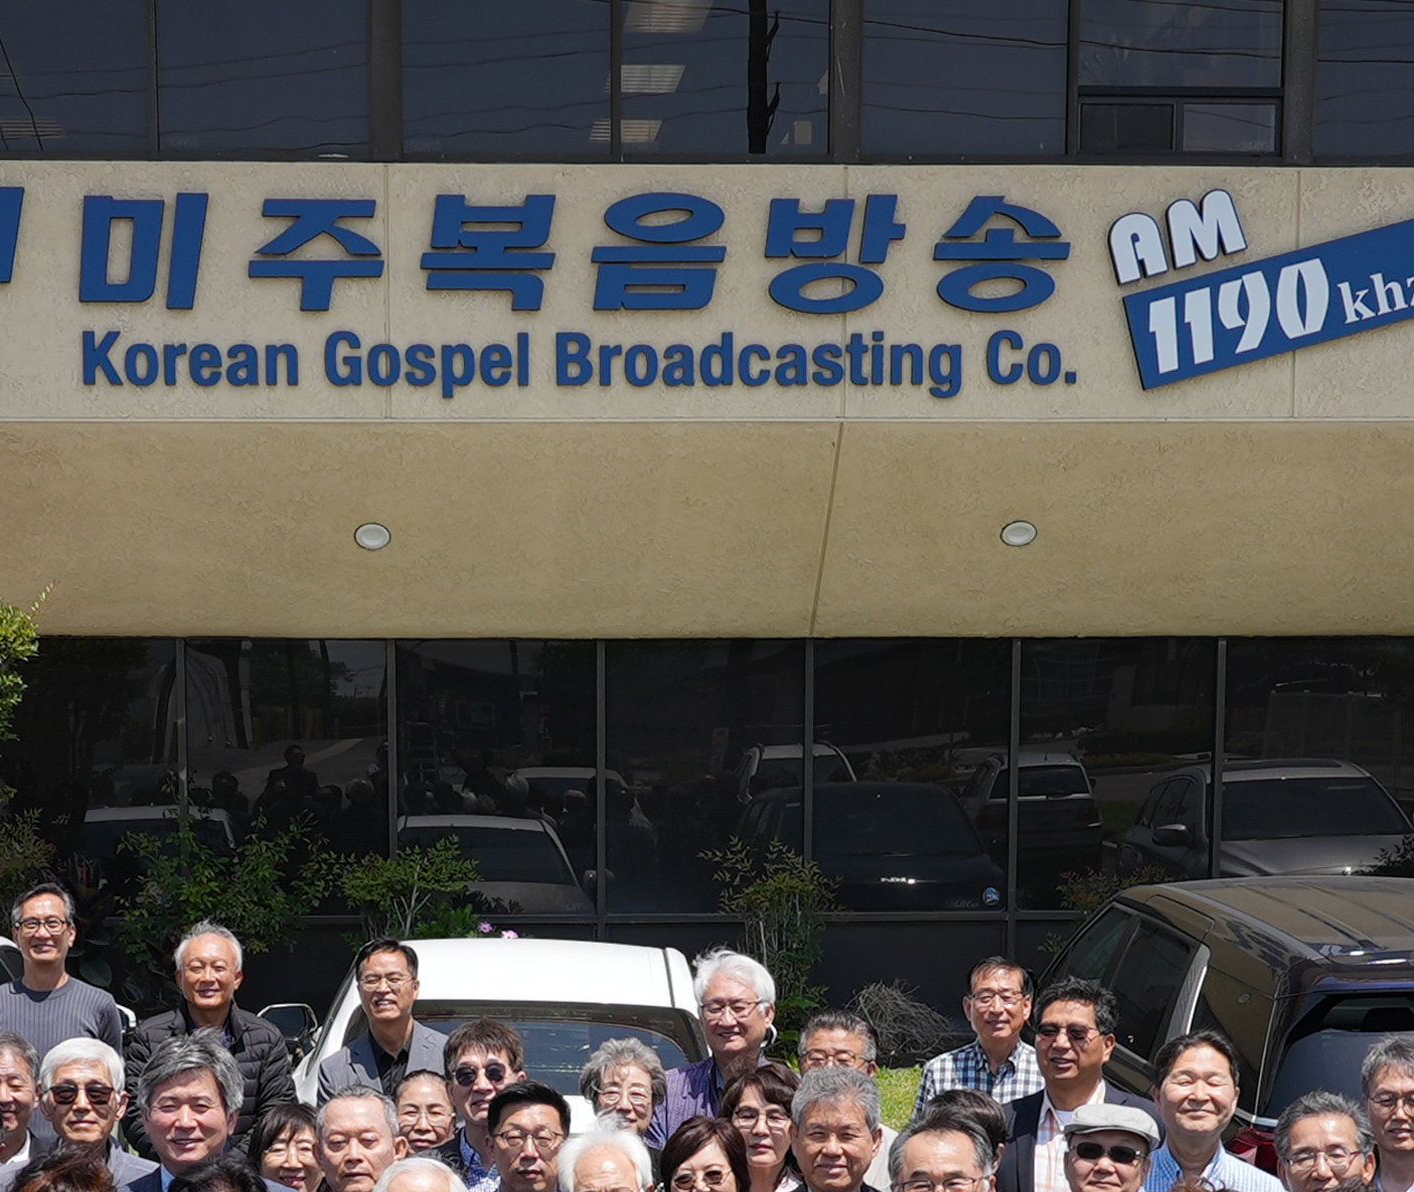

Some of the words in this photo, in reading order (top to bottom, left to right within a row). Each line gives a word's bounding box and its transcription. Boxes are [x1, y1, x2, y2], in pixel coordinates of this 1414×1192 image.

[1108, 188, 1247, 286] AM
[82, 331, 299, 387] Korean
[323, 331, 530, 399] Gospel
[555, 330, 963, 399] Broadcasting
[986, 329, 1078, 387] Co.
[1148, 257, 1331, 375] 1190
